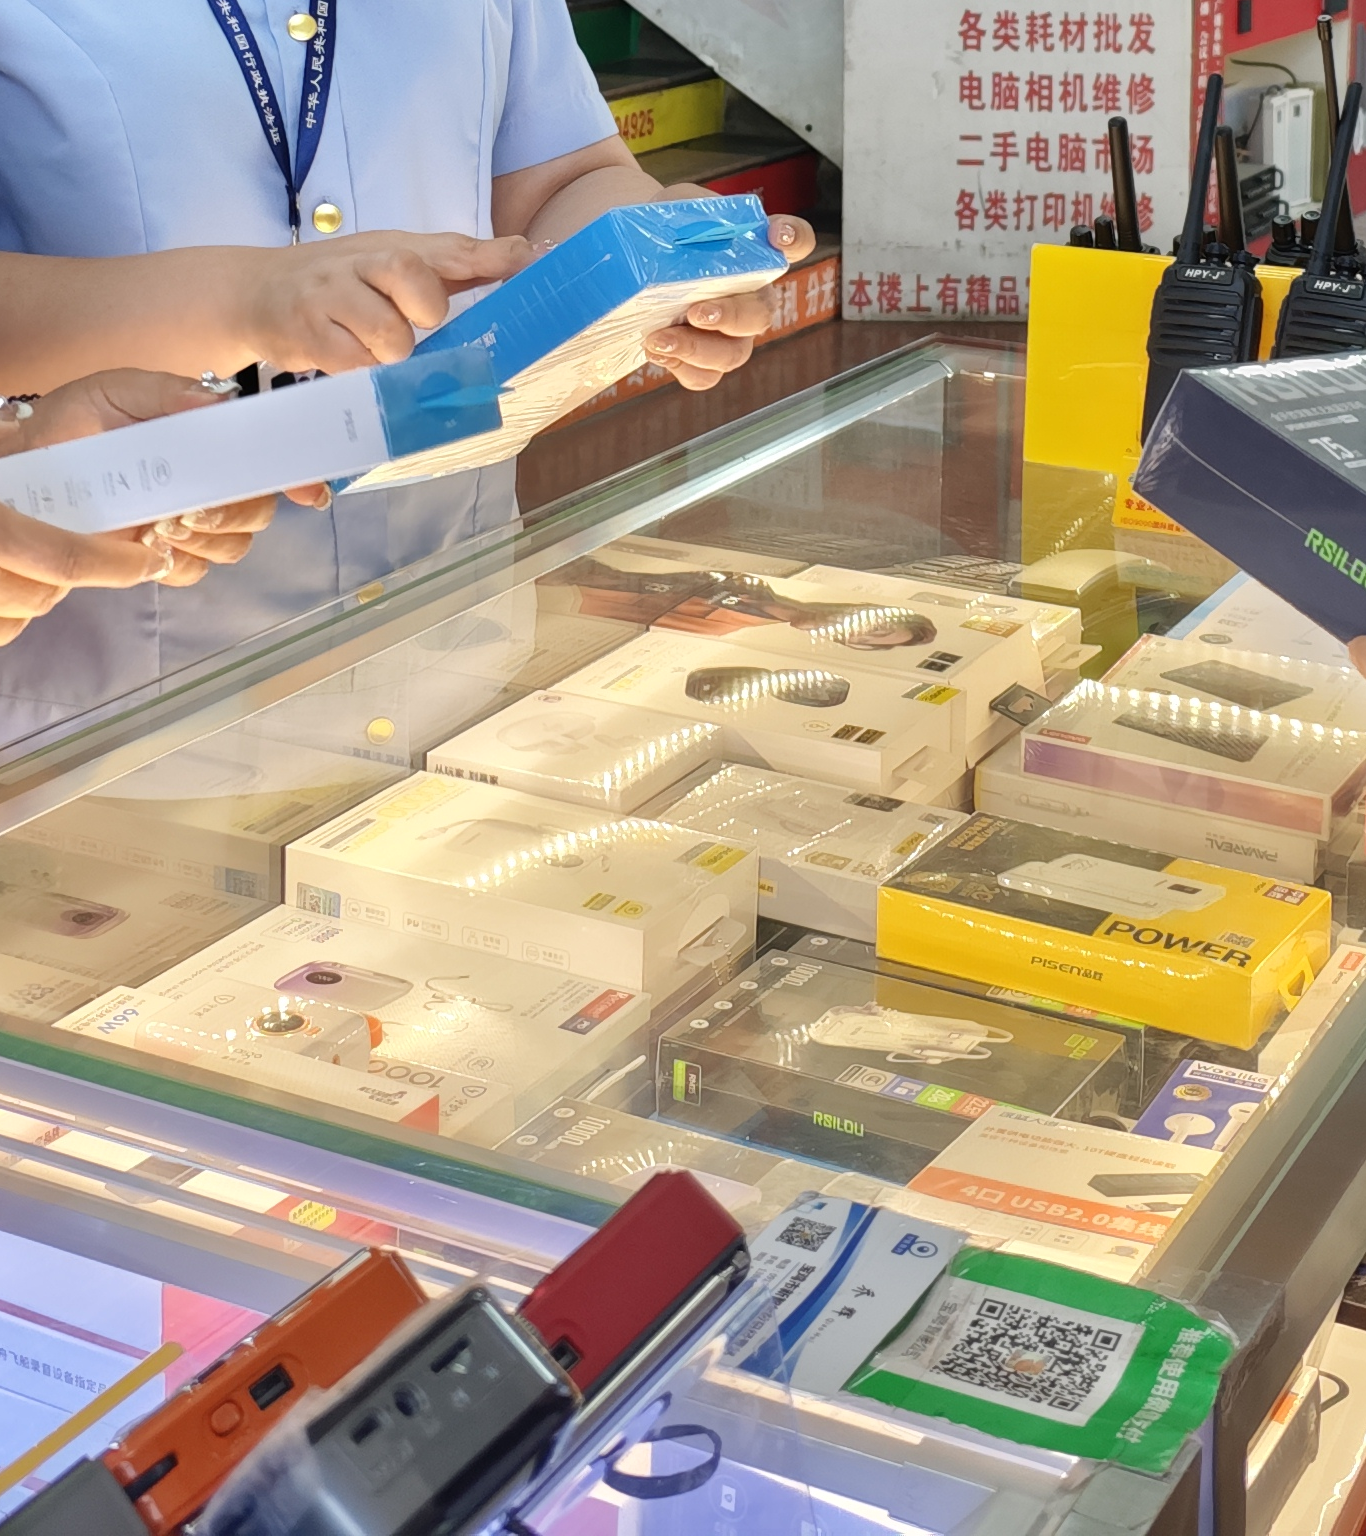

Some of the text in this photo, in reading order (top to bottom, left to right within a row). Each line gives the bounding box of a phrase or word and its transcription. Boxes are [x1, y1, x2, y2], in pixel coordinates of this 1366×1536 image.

[957, 9, 1157, 56] 各类耗材批发
[958, 70, 1157, 116] 电脑相机维修
[847, 271, 1031, 317] 本楼上有精品
[1103, 919, 1252, 968] POWER
[1195, 1062, 1267, 1084] Woolike
[812, 1110, 865, 1138] RSILOU
[960, 1185, 1006, 1204] 4口
